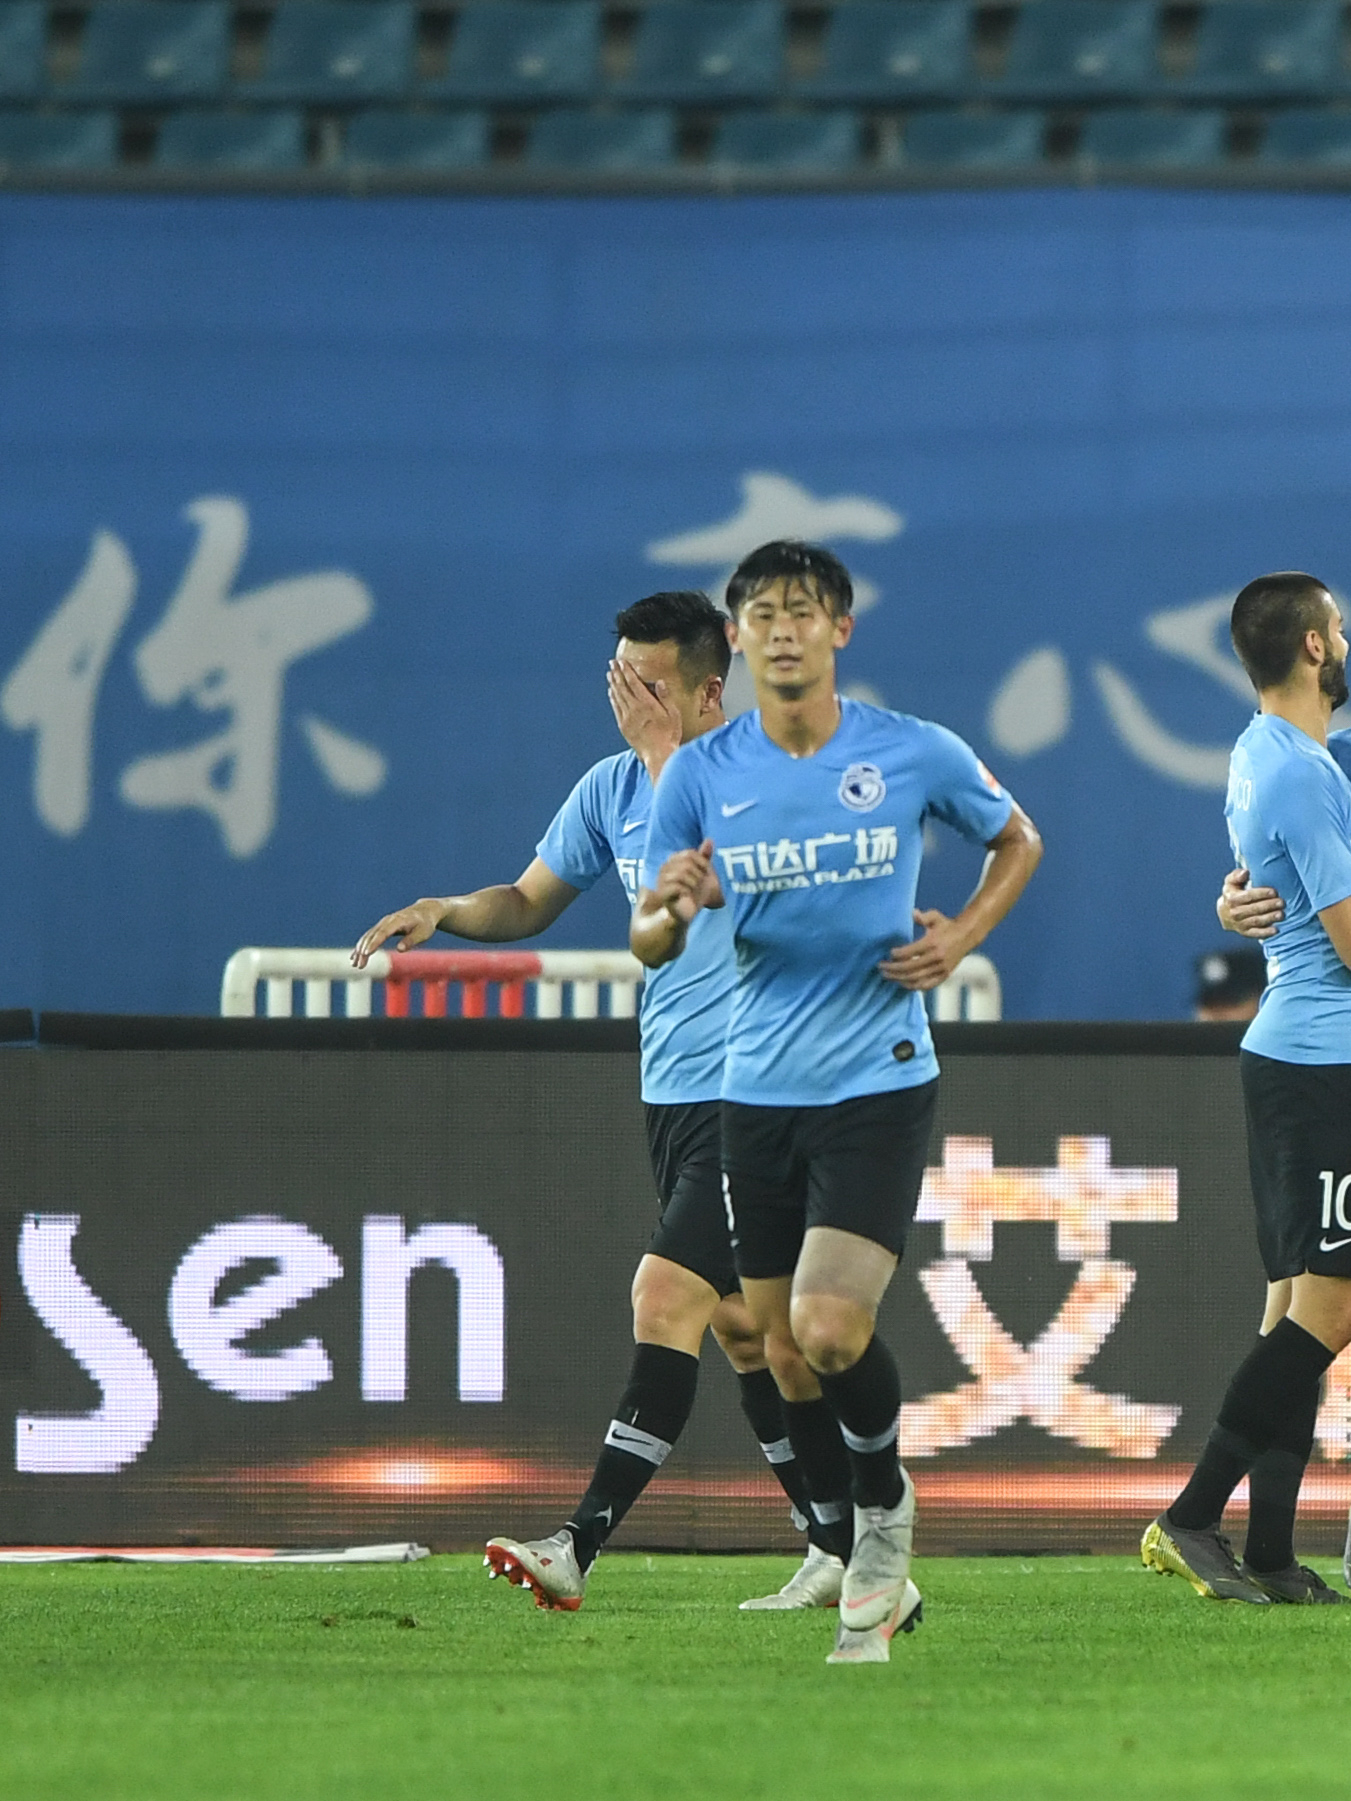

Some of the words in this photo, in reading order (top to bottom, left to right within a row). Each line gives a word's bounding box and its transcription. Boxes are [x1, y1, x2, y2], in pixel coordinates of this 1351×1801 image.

[718, 826, 897, 880] 万达广场
[615, 858, 646, 890] 万
[814, 862, 895, 886] PLAZA
